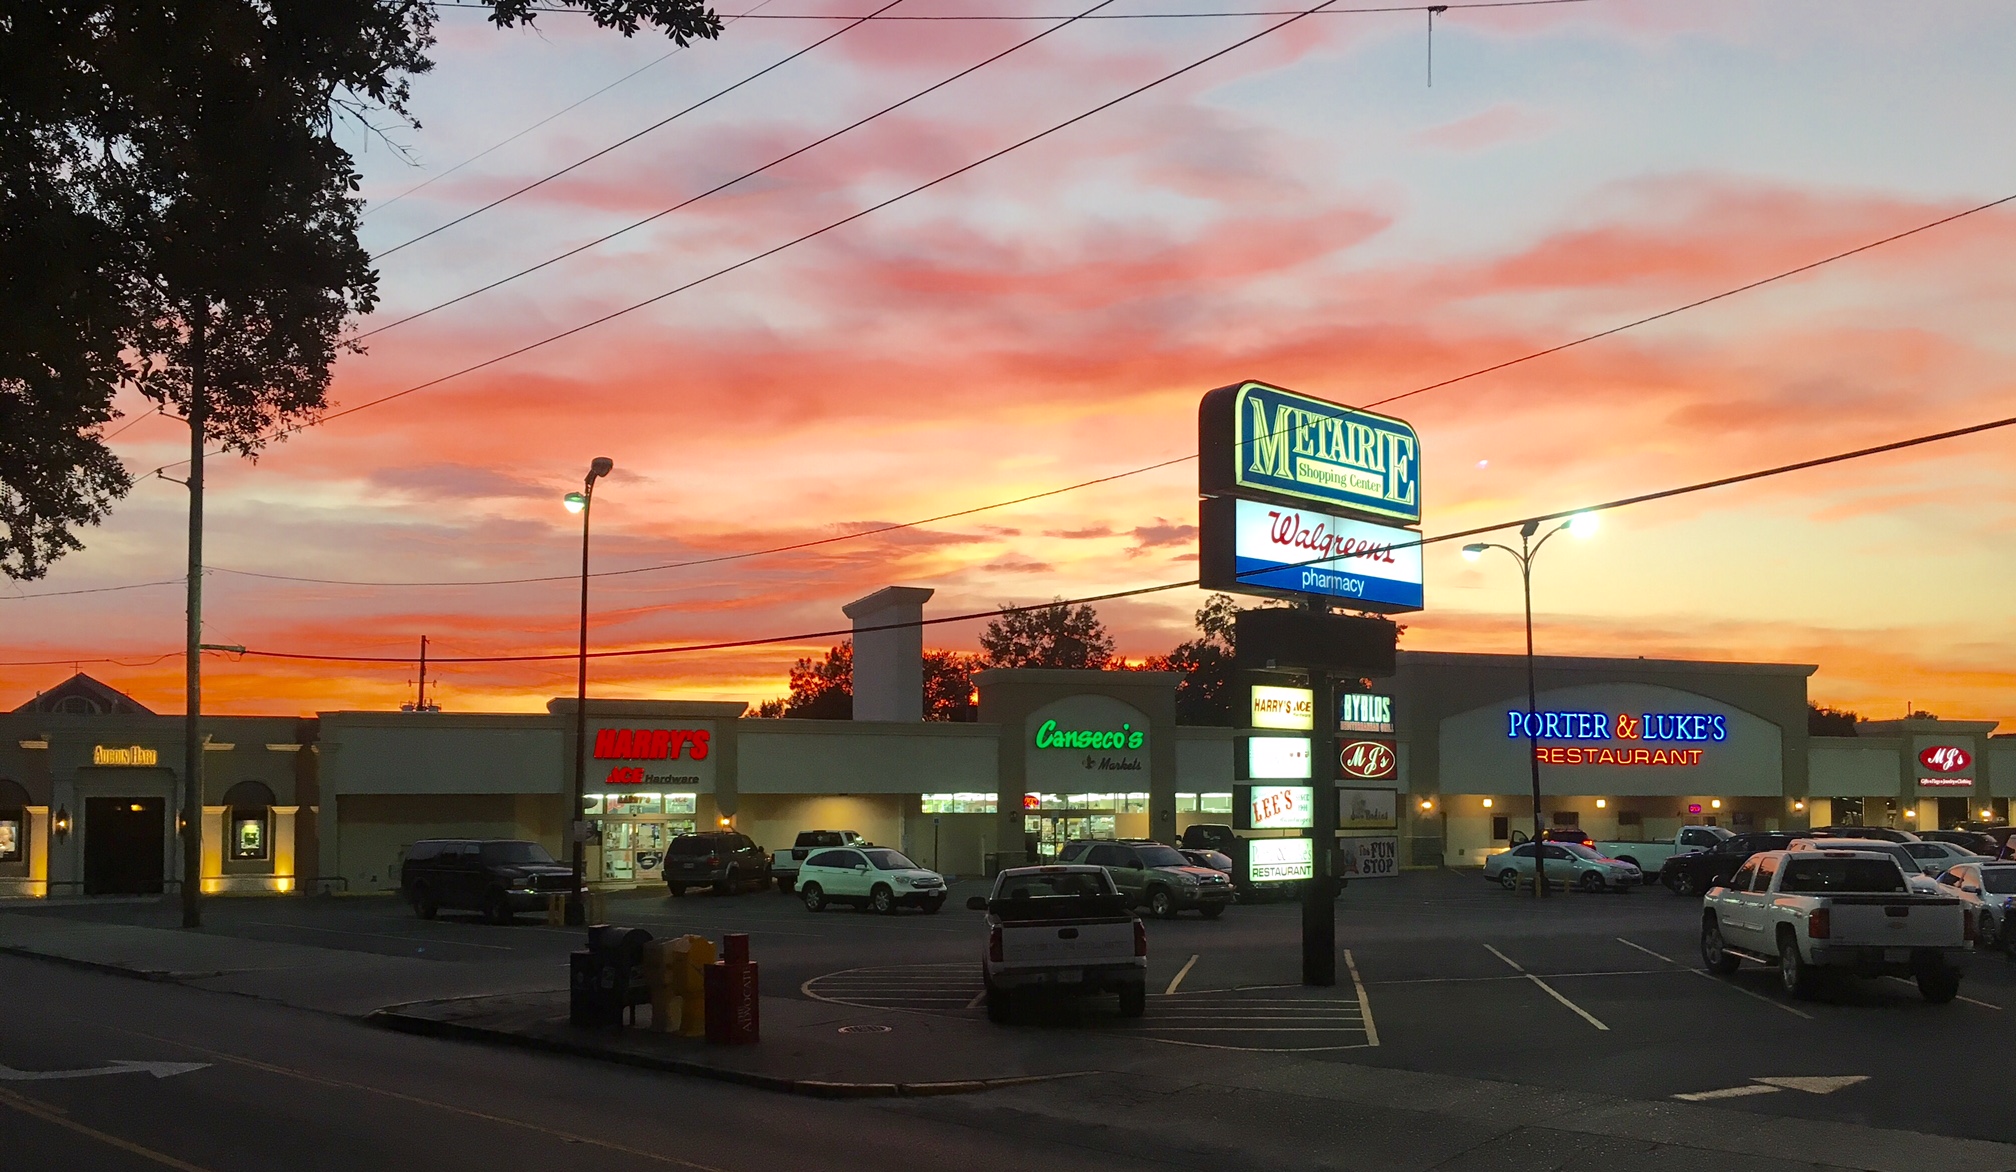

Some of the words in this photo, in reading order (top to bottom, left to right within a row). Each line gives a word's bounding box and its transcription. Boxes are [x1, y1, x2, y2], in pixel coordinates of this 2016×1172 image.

[1248, 396, 1416, 506] METAIRIE
[1299, 463, 1347, 488] Shopping
[1350, 474, 1382, 493] Center
[1268, 510, 1395, 564] Walgreens
[1302, 568, 1365, 597] pharmacy
[1254, 698, 1291, 714] HARRY'S
[1293, 701, 1311, 712] ACE
[1344, 694, 1391, 723] BYBLOS
[1036, 719, 1144, 749] Canseco's
[1508, 711, 1611, 740] PORTER
[1615, 713, 1639, 740] &
[1642, 714, 1727, 741] LUKE'S
[594, 728, 711, 760] HARRY'S
[1536, 747, 1703, 765] RESTAURANT
[605, 766, 645, 783] ACE
[645, 774, 700, 784] Hardware
[1097, 757, 1143, 771] Markets
[1252, 789, 1293, 824] LEE'S
[1370, 841, 1395, 858] FUN
[1252, 865, 1311, 878] RESTAURANT
[1363, 858, 1393, 874] STOP
